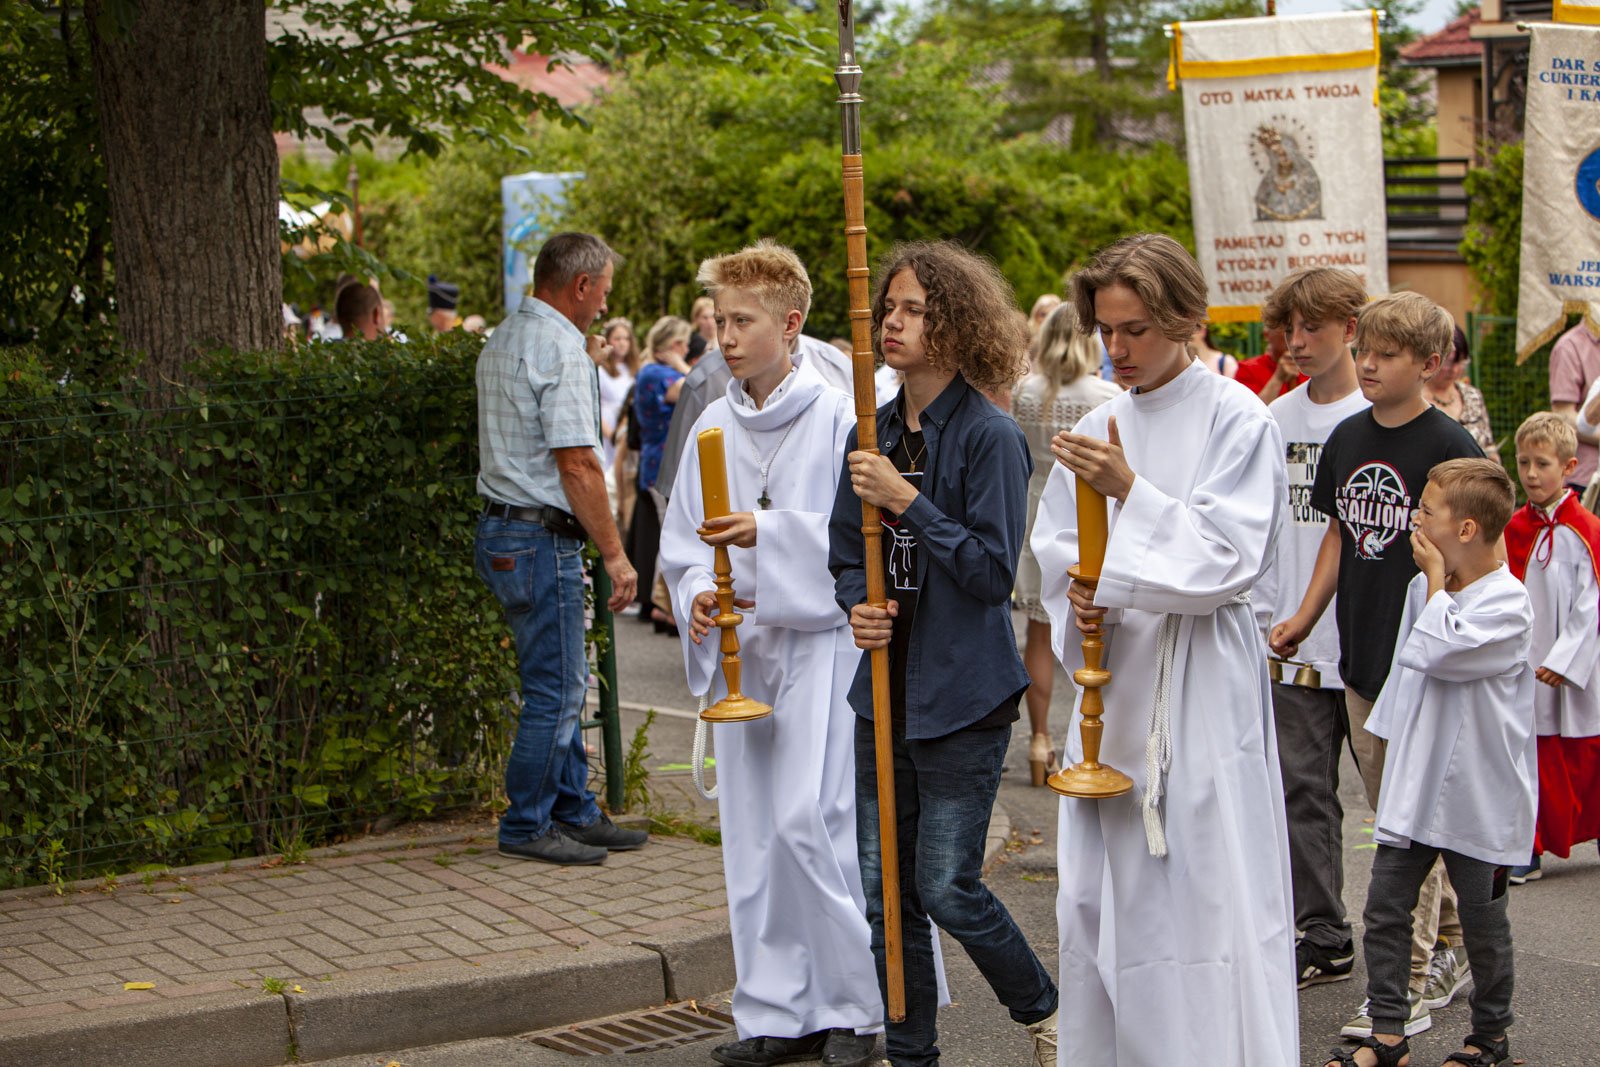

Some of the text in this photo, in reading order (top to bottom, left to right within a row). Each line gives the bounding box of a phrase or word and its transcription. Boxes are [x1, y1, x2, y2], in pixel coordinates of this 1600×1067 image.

[1552, 58, 1586, 71] DAR
[1539, 71, 1600, 86] CUKIER
[1200, 85, 1360, 106] OTO MATKA TWOJA
[1568, 89, 1573, 100] I
[1298, 234, 1310, 246] O
[1323, 231, 1365, 244] TYCH
[1216, 253, 1366, 272] KTÓRZY BUDOWALI
[1218, 280, 1273, 294] TWOJA
